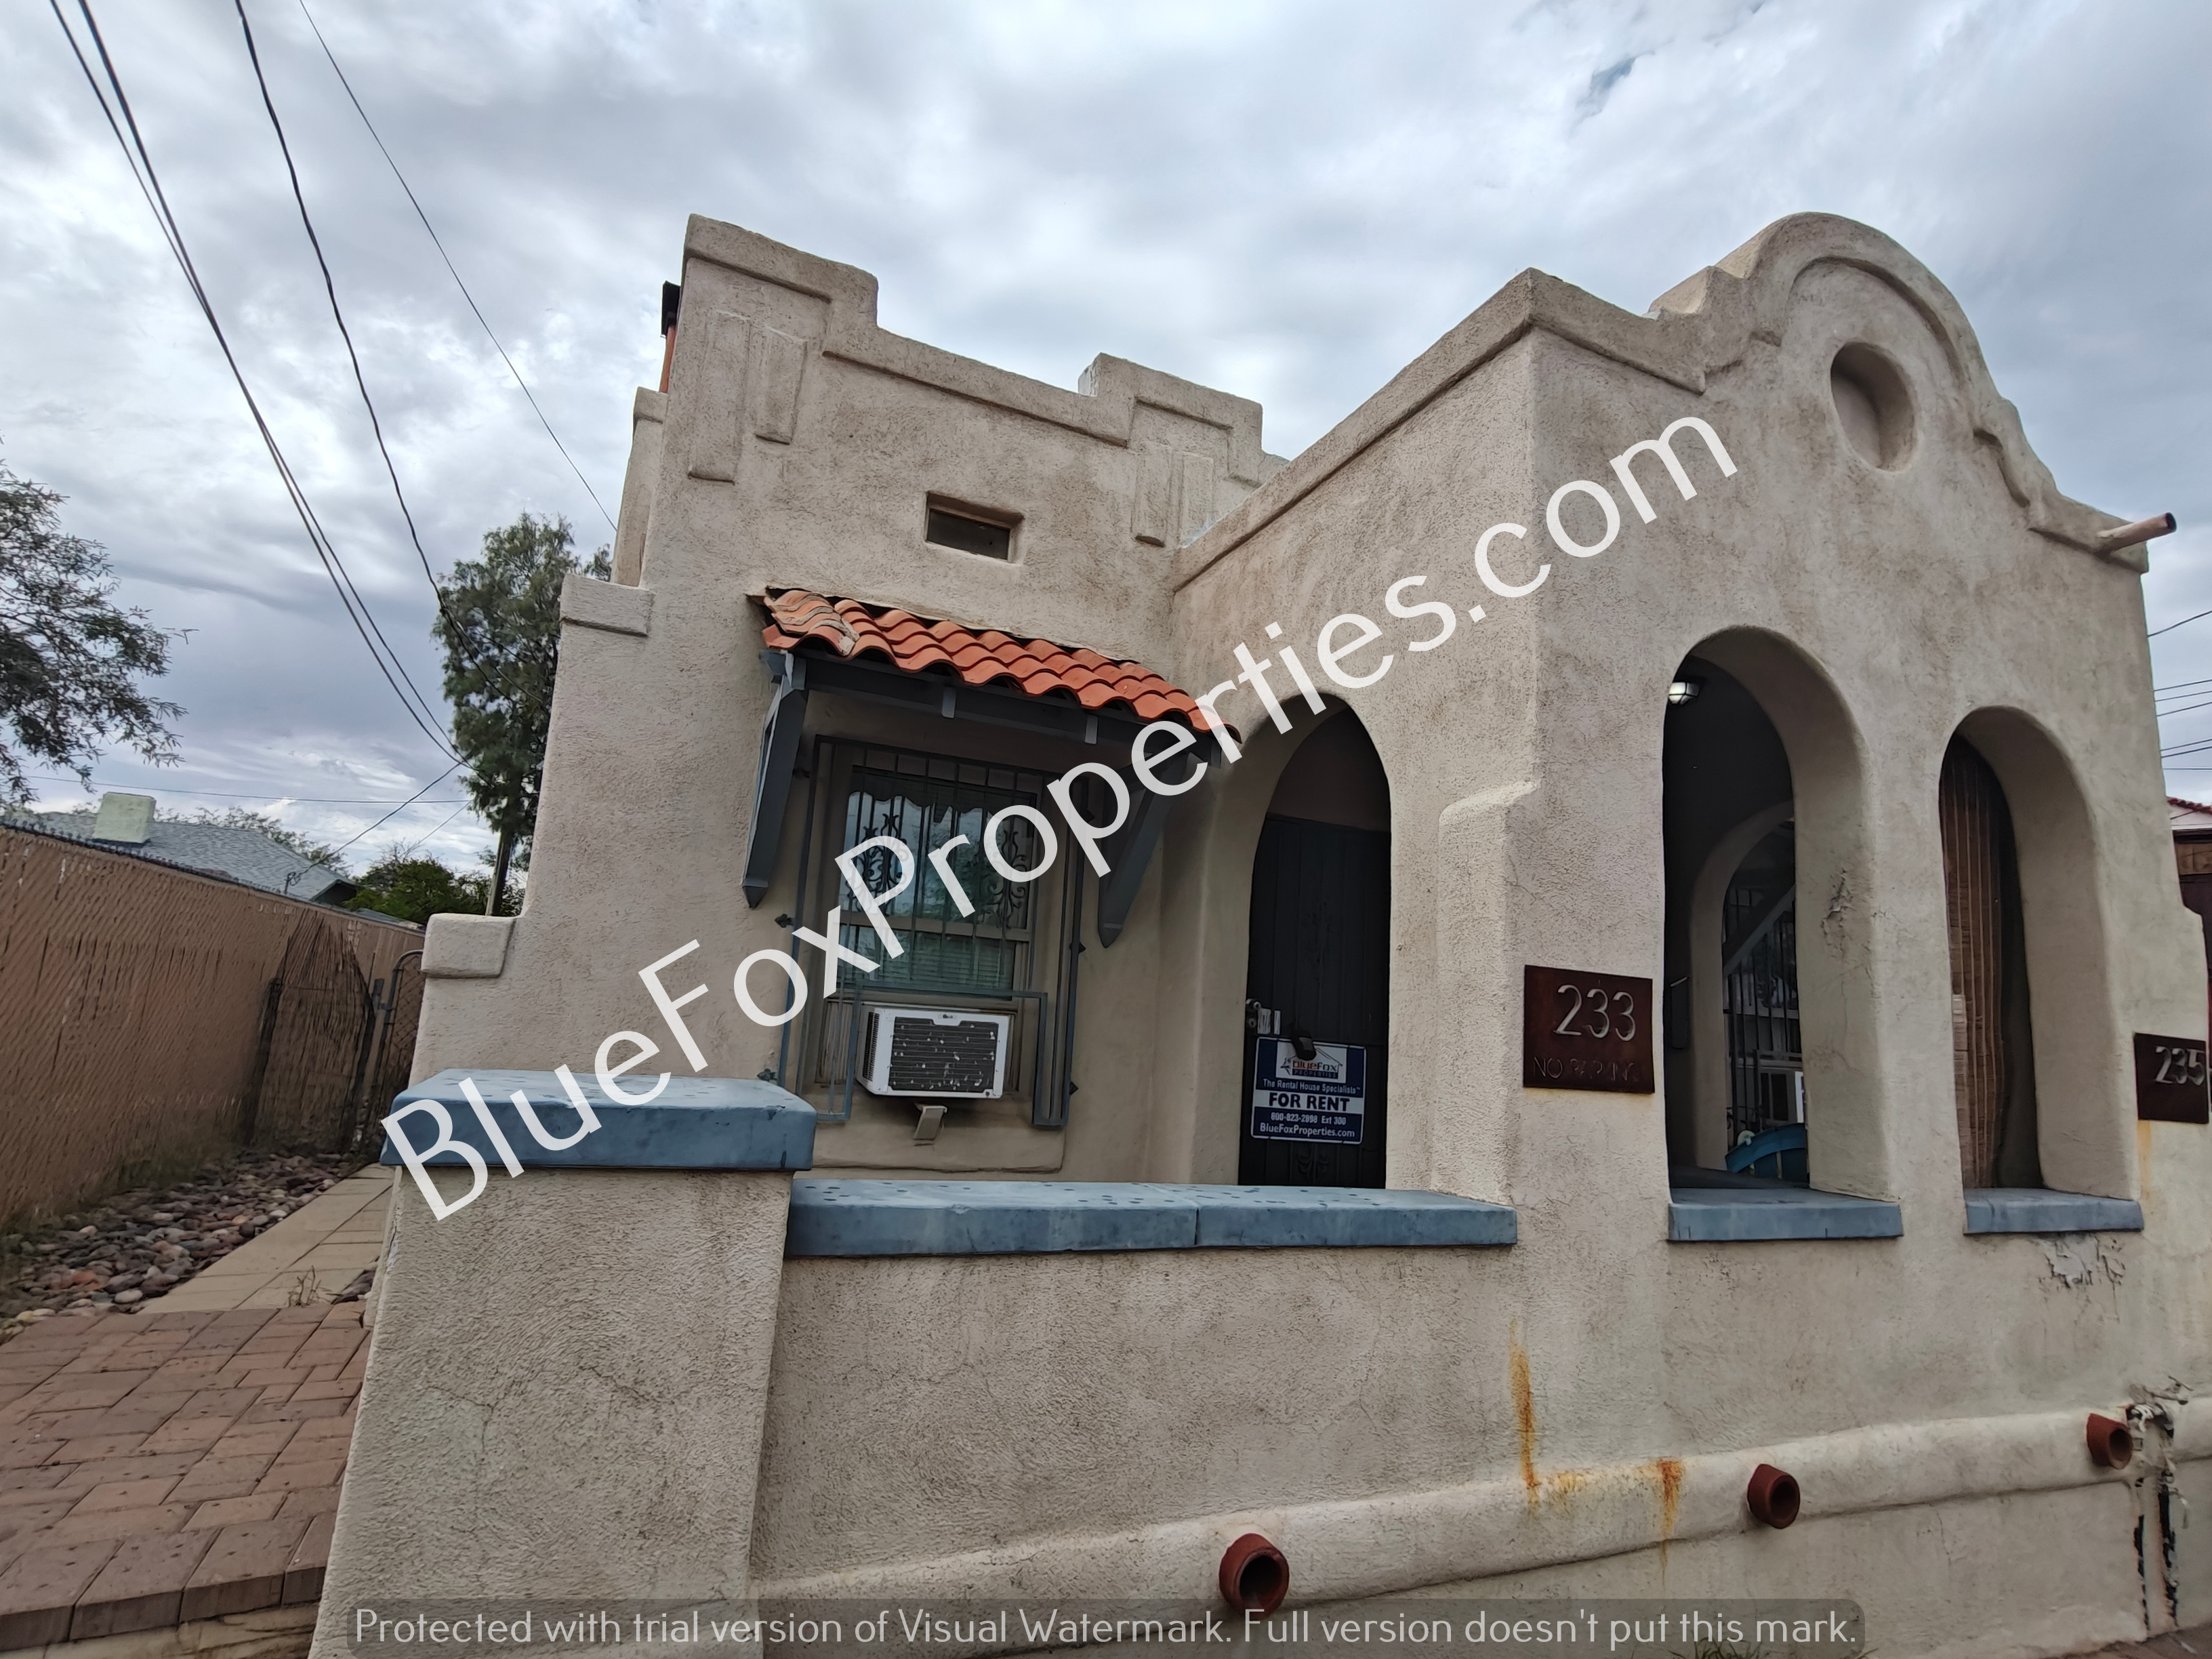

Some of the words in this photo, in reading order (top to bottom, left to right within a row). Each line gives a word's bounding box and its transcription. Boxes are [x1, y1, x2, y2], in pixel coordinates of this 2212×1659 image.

[1553, 985, 1636, 1042] 233
[2153, 1046, 2206, 1086] 235
[1263, 1079, 1275, 1088] The
[1277, 1080, 1298, 1090] Rental
[1300, 1082, 1320, 1092] House
[1269, 1092, 1300, 1108] FOR
[1307, 1095, 1350, 1111] RENT
[1321, 1116, 1332, 1124] Ext
[1334, 1117, 1347, 1126] 300
[1260, 1122, 1355, 1138] BlueFoxProperties.com
